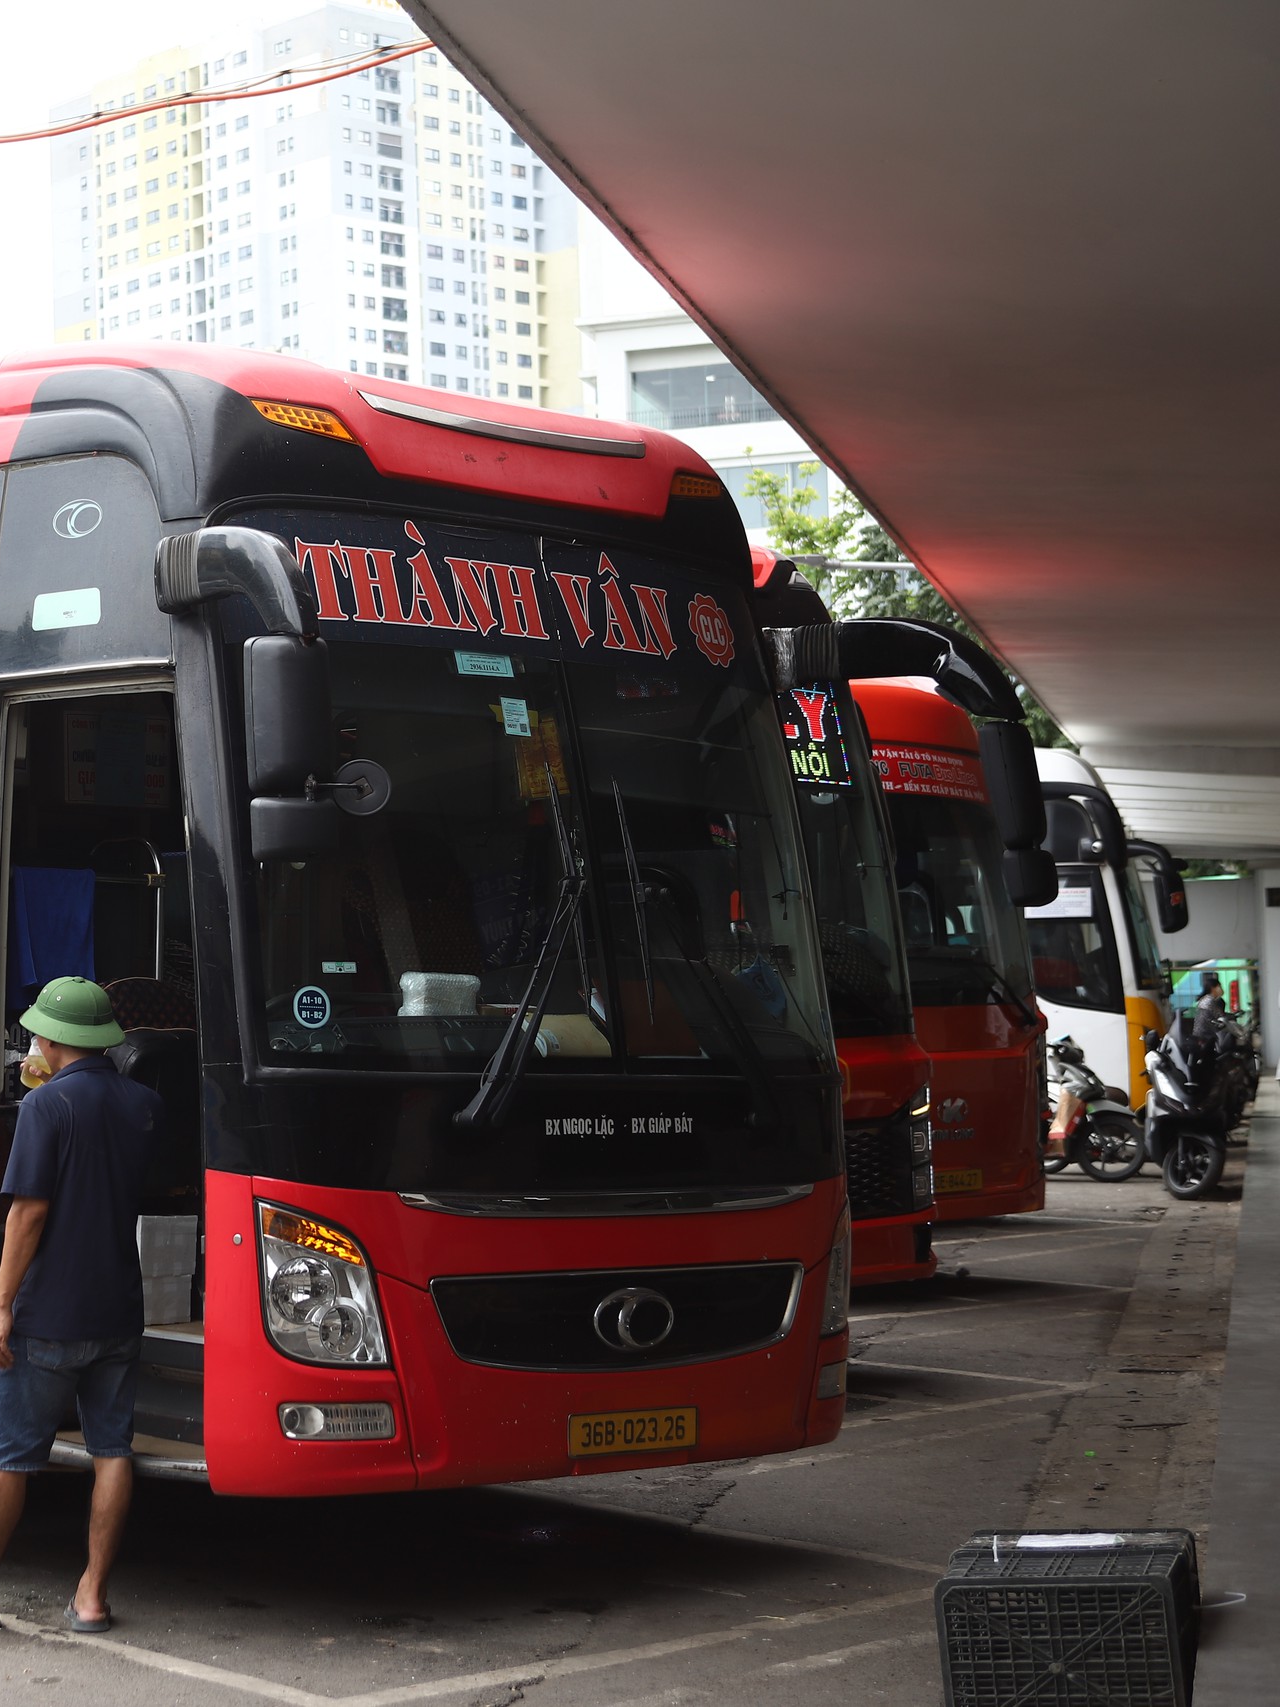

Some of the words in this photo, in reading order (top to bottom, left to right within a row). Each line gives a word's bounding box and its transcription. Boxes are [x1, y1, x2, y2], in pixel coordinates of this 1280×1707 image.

[294, 519, 550, 641] THÀNH
[550, 551, 677, 660] VÂN
[698, 613, 727, 648] CLC
[790, 742, 830, 780] NỘI
[879, 748, 898, 759] VẬN
[897, 761, 936, 779] FUTA
[903, 780, 920, 792] BẾN
[921, 784, 931, 793] XE
[932, 783, 949, 795] GIÁP
[301, 995, 322, 1005] A1-10
[301, 1010, 323, 1019] B1-B2
[545, 1119, 561, 1135] BX
[562, 1118, 592, 1138] NGỌC
[594, 1115, 614, 1139] LẶC
[631, 1117, 646, 1134] BX
[648, 1112, 672, 1134] GIÁP
[674, 1112, 693, 1134] BÁT
[581, 1415, 685, 1448] 36B-023.26
